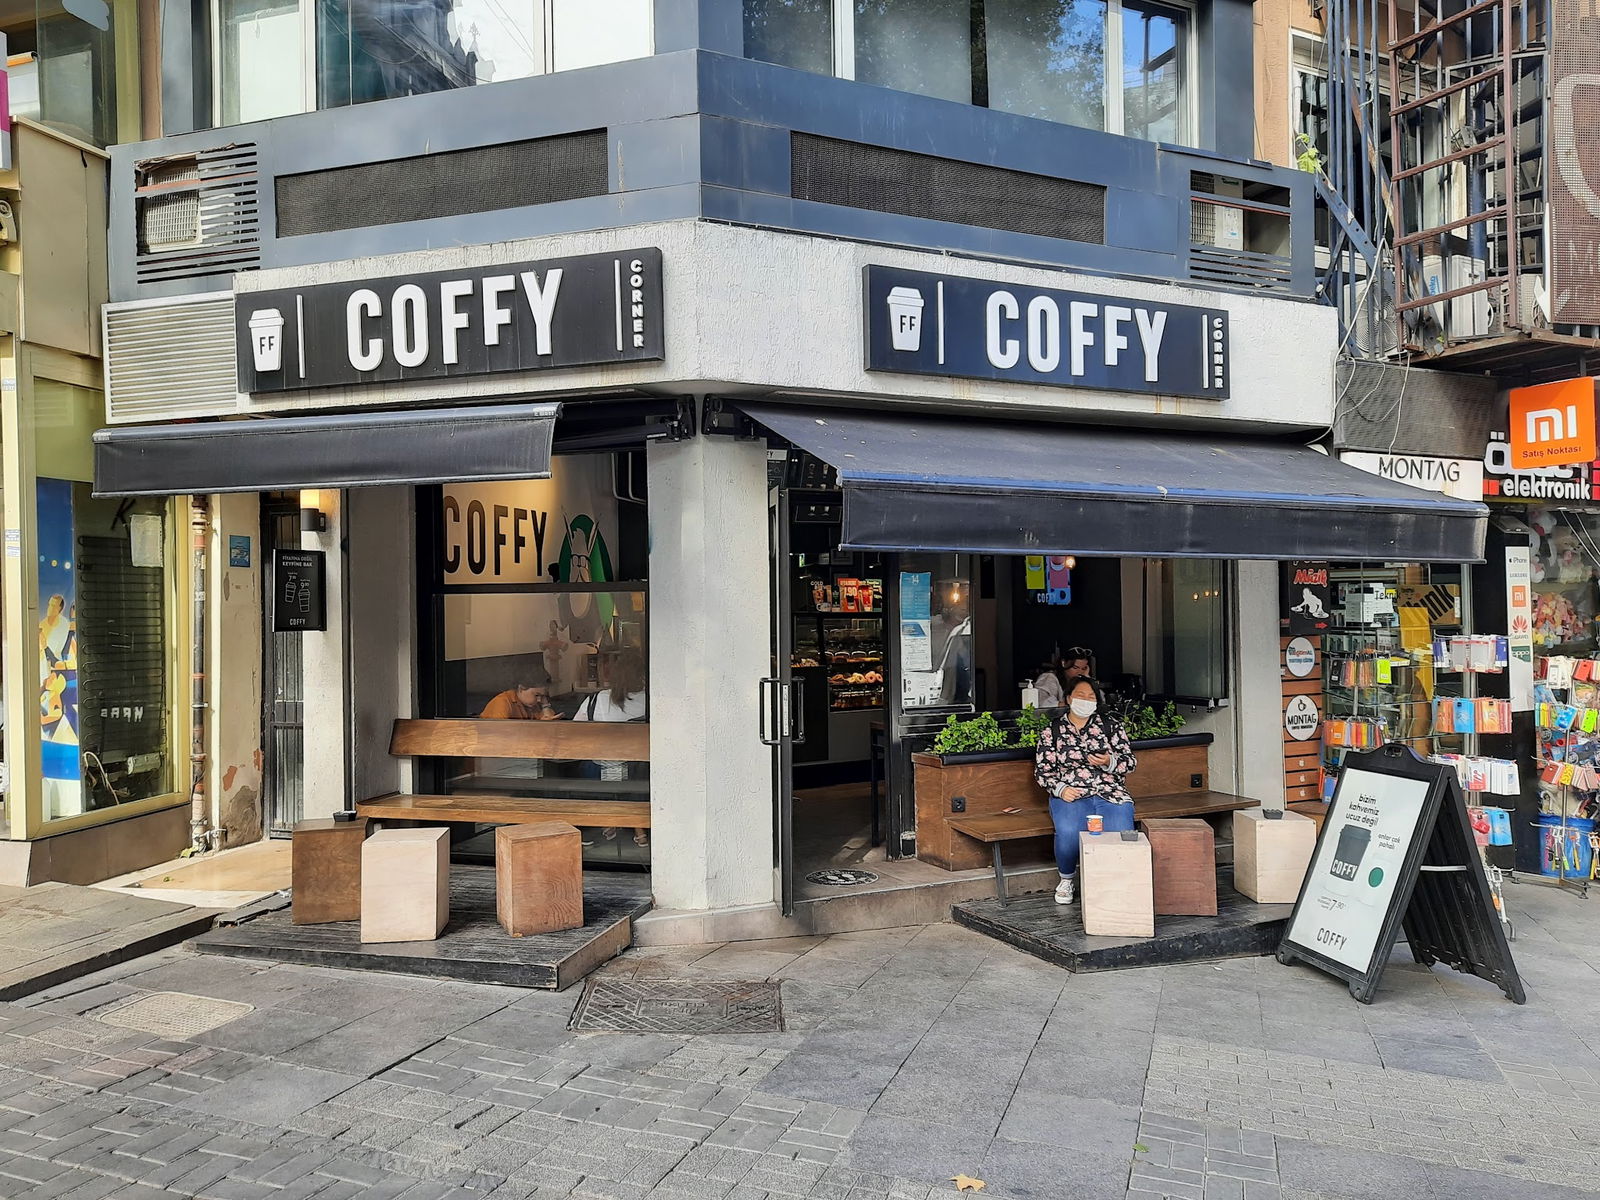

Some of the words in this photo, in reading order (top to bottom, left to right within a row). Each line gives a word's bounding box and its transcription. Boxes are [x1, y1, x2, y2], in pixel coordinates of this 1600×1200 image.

[629, 259, 644, 348] CORNER
[346, 268, 564, 371] COFFY
[900, 315, 916, 333] FF
[259, 336, 275, 355] FF
[986, 290, 1168, 382] COFFY
[1213, 317, 1224, 389] CORNER
[1522, 450, 1544, 459] Satış
[1547, 446, 1581, 455] Noktası
[1378, 457, 1460, 482] MONTAG
[1503, 474, 1591, 500] elektronik
[444, 496, 547, 577] COFFY
[289, 618, 306, 626] COFFY
[1287, 713, 1316, 725] MONTAG
[1349, 802, 1379, 816] kahvemiz
[1359, 794, 1376, 805] bizim
[1345, 813, 1361, 822] ucuz
[1331, 859, 1358, 879] COFFY
[1317, 927, 1347, 951] COFFY
